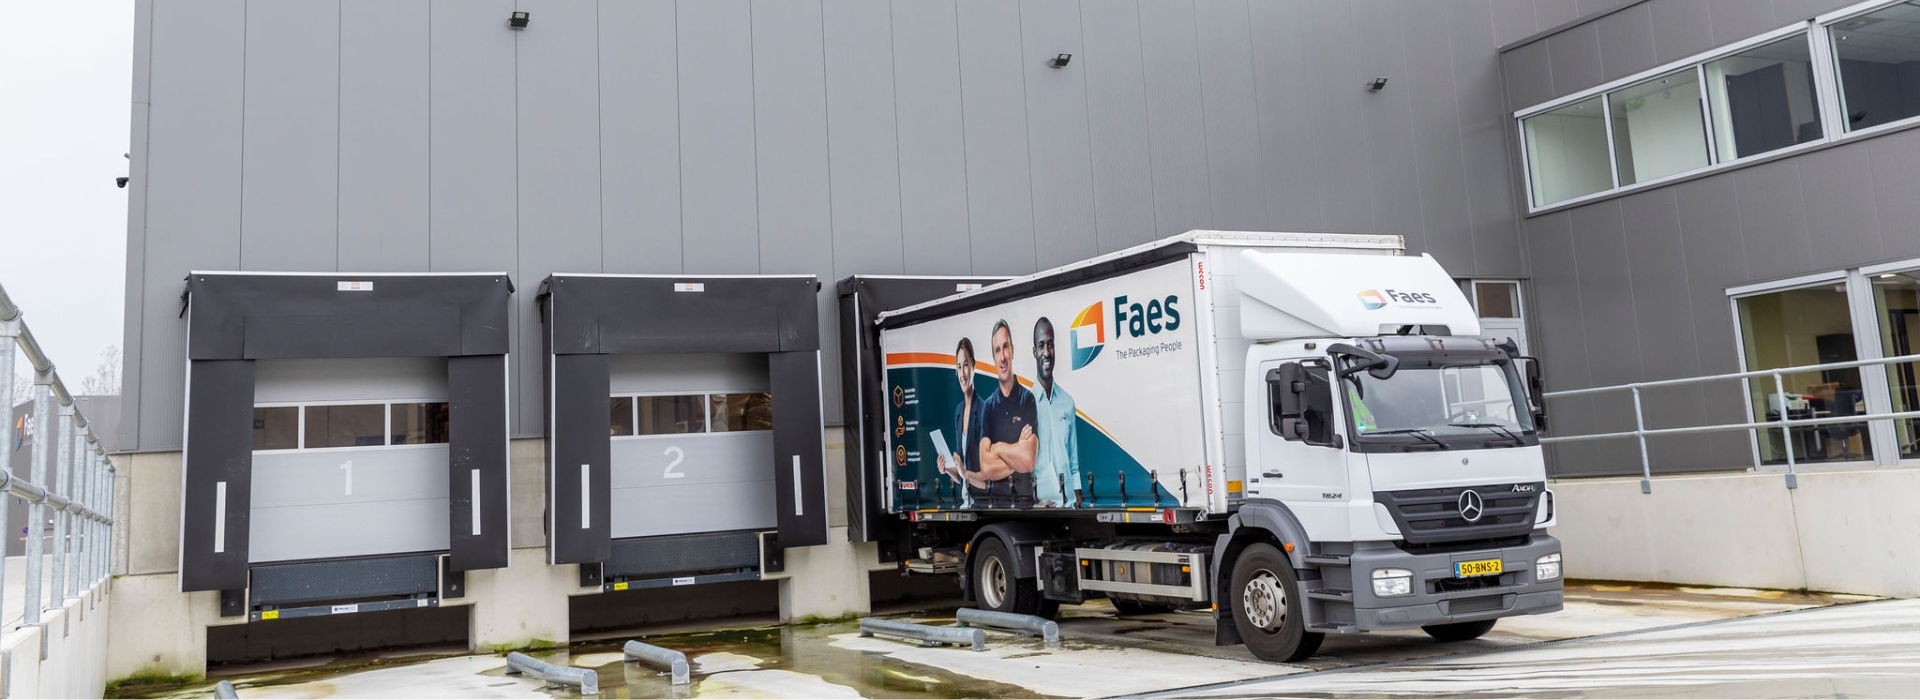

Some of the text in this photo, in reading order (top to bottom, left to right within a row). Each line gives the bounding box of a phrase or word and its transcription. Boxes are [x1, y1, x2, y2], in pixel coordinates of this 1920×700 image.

[1385, 290, 1436, 303] Faes
[1114, 294, 1181, 340] Faes
[1116, 340, 1182, 360] The Packaging People
[663, 447, 684, 478] 2
[340, 460, 352, 495] 1
[1461, 562, 1499, 573] 50-BNS-2
